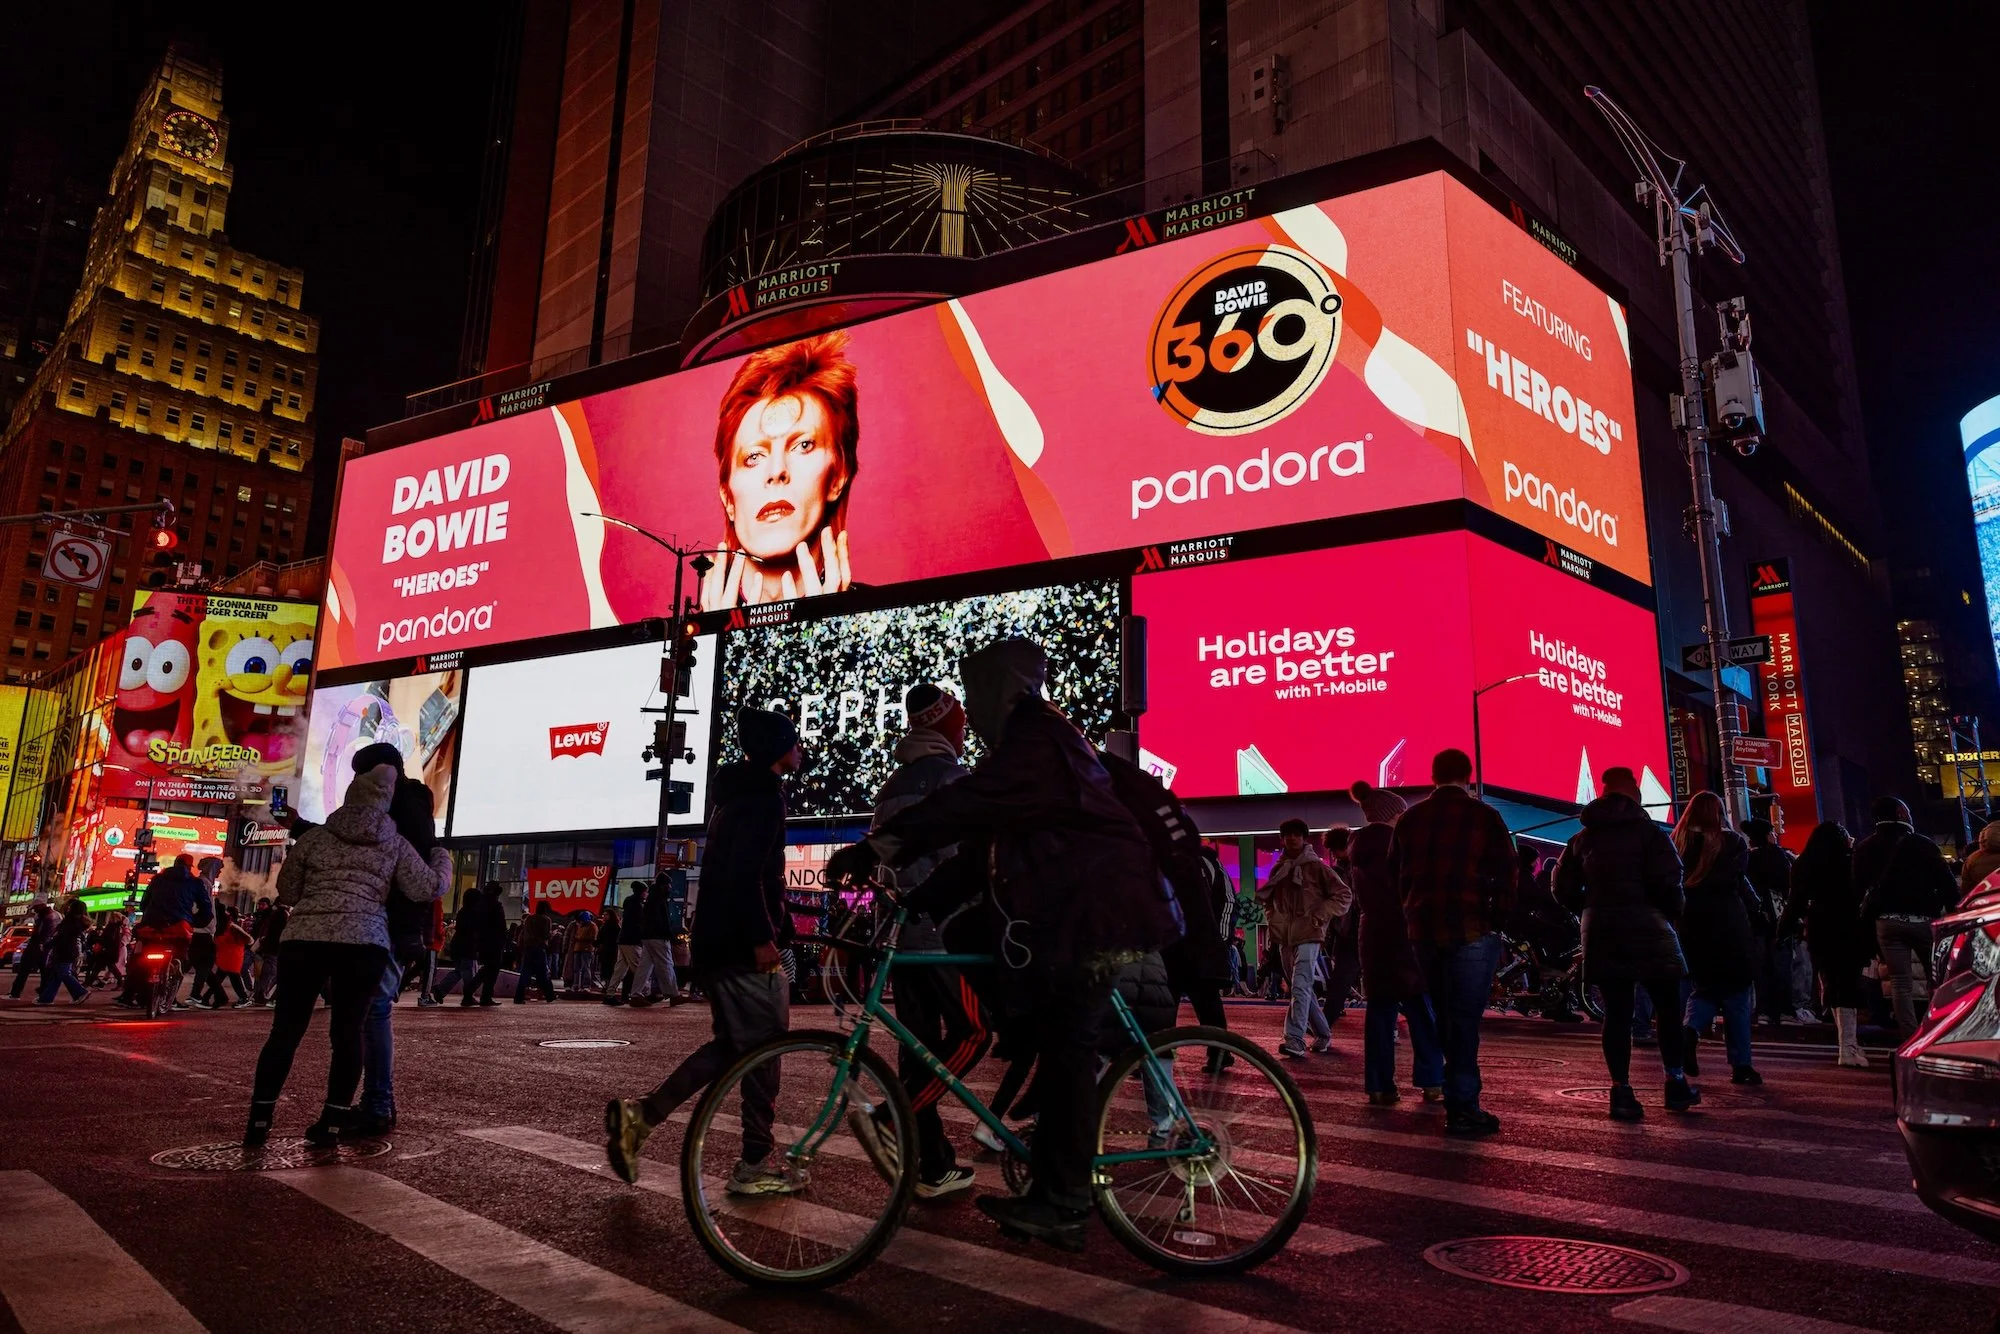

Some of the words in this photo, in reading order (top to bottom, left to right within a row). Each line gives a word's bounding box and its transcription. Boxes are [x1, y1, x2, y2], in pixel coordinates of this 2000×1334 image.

[1165, 188, 1256, 223] MARRIOTT
[1165, 206, 1245, 238] MARQUIS
[1532, 219, 1577, 261] MARRIOTT
[758, 263, 841, 291] MARRIOTT
[757, 280, 829, 306] MARQUIS
[1214, 291, 1268, 315] BOWIE
[1215, 280, 1267, 303] DAVID
[1502, 279, 1593, 362] FEATURING
[501, 383, 552, 404] MARRIOTT
[1466, 328, 1623, 456] "HEROES"
[500, 396, 543, 415] MARQUIS
[391, 453, 511, 515] DAVID
[382, 500, 510, 565] BOWIE
[1170, 548, 1227, 566] MARQUIS
[1171, 537, 1234, 554] MARRIOTT
[1560, 547, 1593, 571] MARRIOTT
[1561, 557, 1590, 580] MARQUIS
[393, 561, 489, 598] "HEROES"
[1758, 581, 1789, 591] MARRIOTT
[217, 600, 251, 610] GONNA
[254, 603, 278, 612] NEED
[233, 609, 268, 619] SCREEN
[750, 602, 795, 616] MARRIOTT
[749, 612, 789, 625] MARQUIS
[1197, 625, 1356, 662] Holidays
[1529, 630, 1607, 680] Holidays
[1730, 644, 1758, 659] WAY
[429, 660, 459, 670] MARQUIS
[430, 651, 464, 662] MARRIOTT
[1209, 663, 1266, 688] are
[1275, 648, 1395, 683] better
[1275, 684, 1311, 700] with
[1313, 679, 1387, 697] T-Mobile
[1538, 666, 1570, 695] are
[1571, 674, 1623, 711] better
[1766, 672, 1781, 711] YORK
[1572, 702, 1590, 719] with
[1590, 705, 1622, 728] T-Mobile
[1778, 633, 1798, 709] MARRIOTT
[1788, 716, 1808, 786] MARQUIS
[148, 738, 261, 766] SPONGEBOB
[159, 789, 189, 797] NOW
[191, 791, 236, 800] PLAYING
[168, 782, 202, 790] THEATRES
[240, 821, 290, 845] Paramoun
